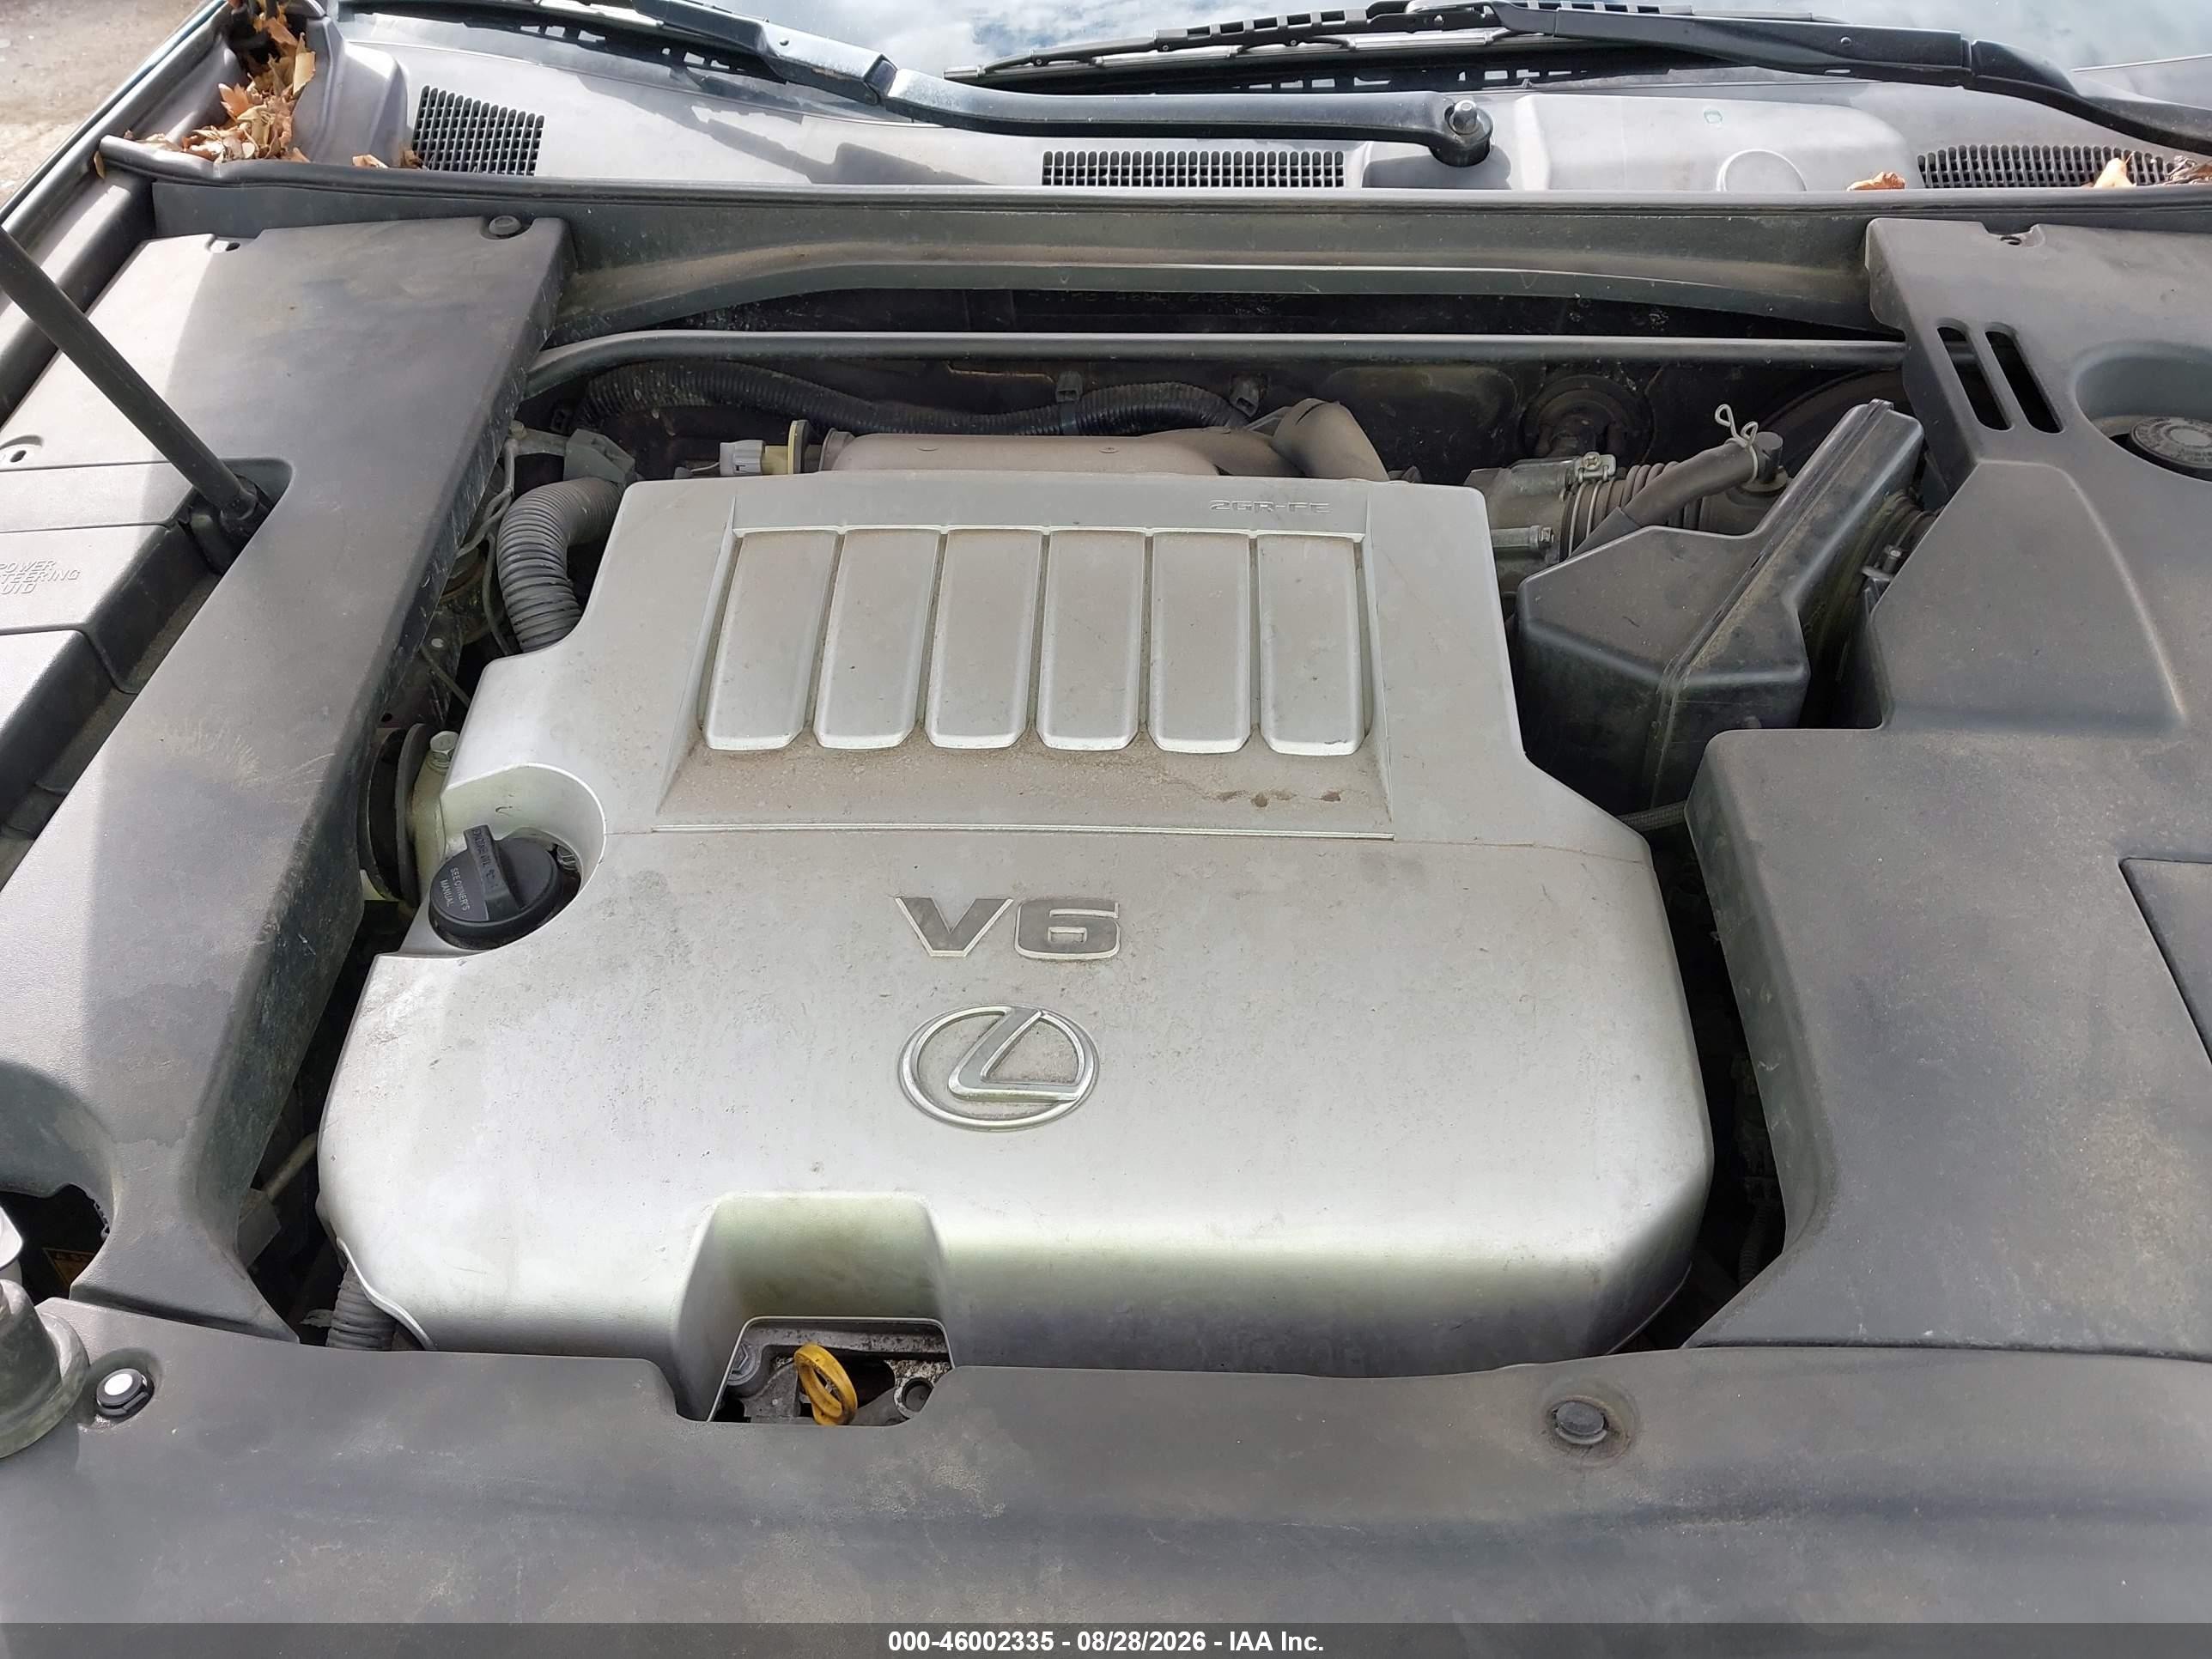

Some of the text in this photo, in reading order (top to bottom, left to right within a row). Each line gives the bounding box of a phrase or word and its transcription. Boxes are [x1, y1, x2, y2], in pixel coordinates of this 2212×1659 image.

[1209, 499, 1331, 514] 2GR-FE
[0, 561, 57, 574] POWER
[0, 569, 81, 584] TEERING
[450, 867, 461, 881] SEE
[440, 878, 454, 908] MANUAL
[895, 897, 1121, 961] V6
